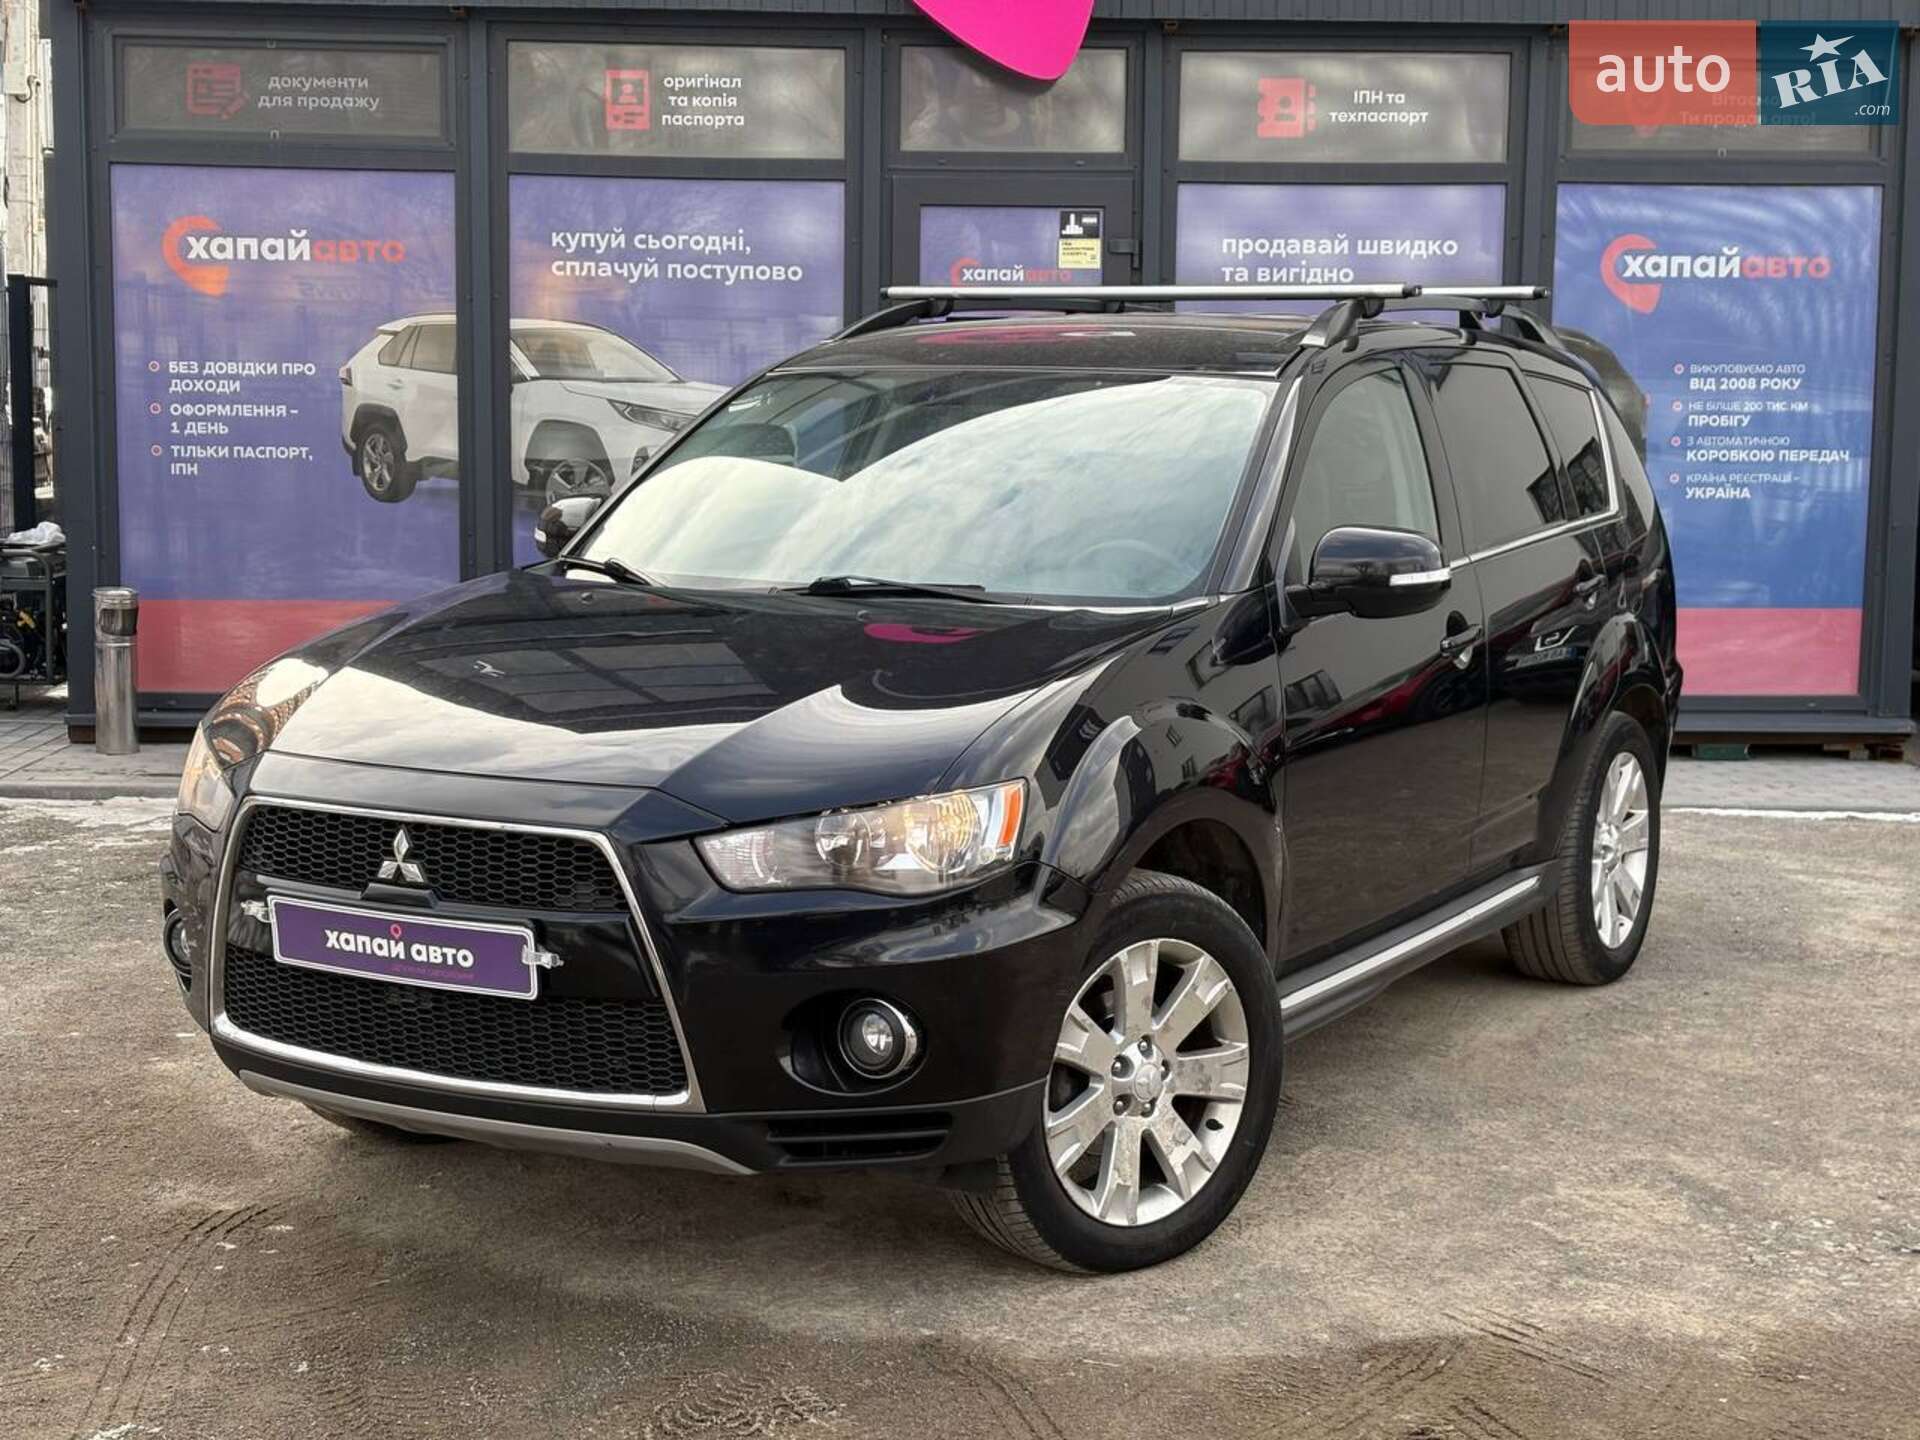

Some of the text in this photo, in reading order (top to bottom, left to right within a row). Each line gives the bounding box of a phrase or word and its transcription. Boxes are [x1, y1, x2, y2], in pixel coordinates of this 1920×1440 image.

[267, 75, 369, 91] документи
[663, 74, 742, 91] оригінал
[257, 96, 380, 111] для продажу
[668, 92, 738, 107] та копія
[1353, 90, 1406, 104] ІПН та
[661, 114, 745, 129] паспорта
[1329, 111, 1429, 126] техпаспорт
[551, 227, 751, 255] купуй сьогодні,
[1222, 234, 1458, 260] продавай швидко
[551, 257, 803, 285] сплачуй поступово
[1222, 260, 1354, 284] та вигідно
[169, 361, 316, 376] БЕЗ ДОВІДКИ ПРО
[1689, 364, 1806, 374] ВИКУПОВУЄМО АВТО
[169, 379, 240, 394] ДОХОДИ
[1689, 378, 1802, 391] ВІД 2008 РОКУ
[170, 403, 287, 417] ОФОРМЛЕННЯ
[1689, 402, 1704, 411] НЕ
[1790, 402, 1808, 411] КМ
[171, 421, 229, 436] 1 ДЕНЬ
[1688, 415, 1751, 427] ПРОБІГУ
[1696, 436, 1790, 446] АВТОМАТИЧНОЮ
[171, 445, 313, 461] ТІЛЬКИ ПАСПОРТ,
[1686, 450, 1849, 463] КОРОБКОЮ ПЕРЕДАЧ
[171, 463, 198, 476] ІПН
[1686, 472, 1727, 483] КРАЇНА
[1685, 485, 1751, 499] УКРАЇНА
[410, 942, 475, 969] авто
